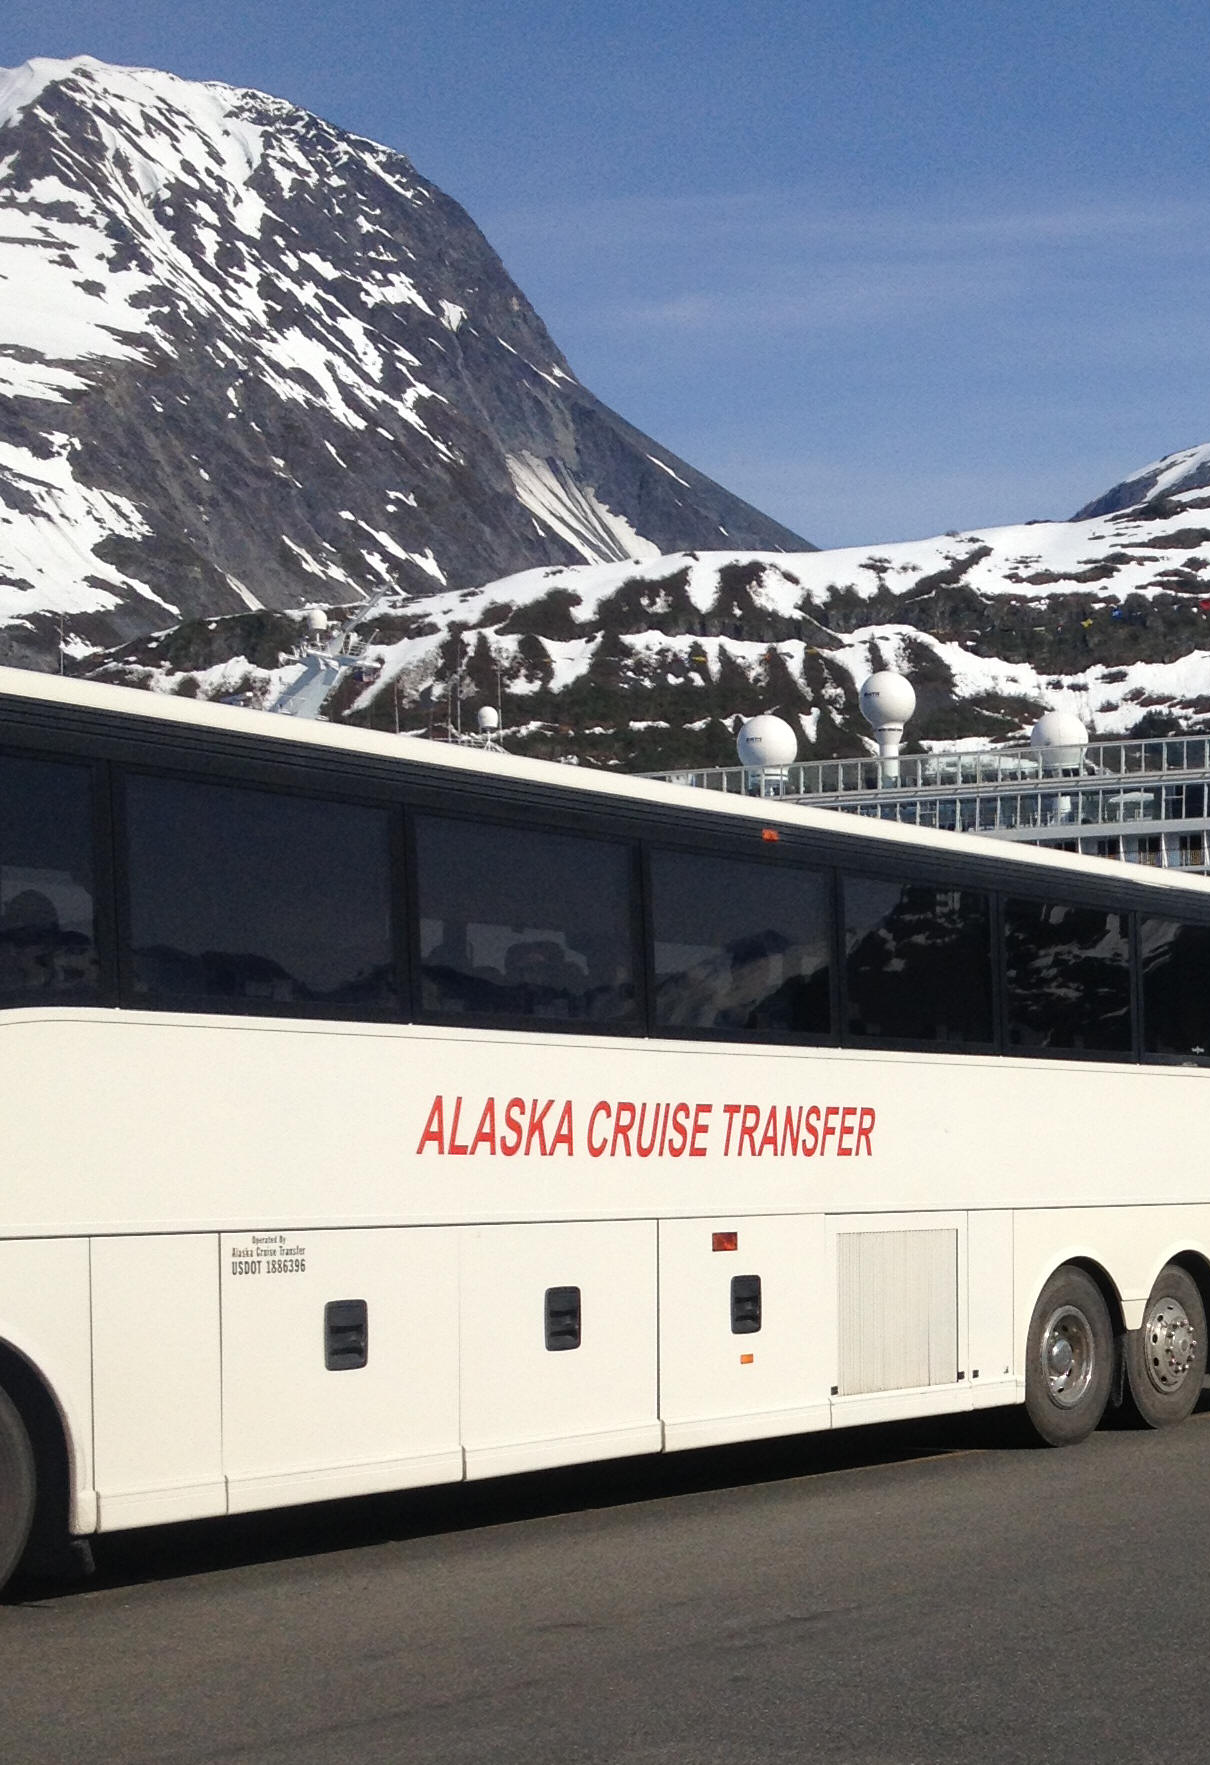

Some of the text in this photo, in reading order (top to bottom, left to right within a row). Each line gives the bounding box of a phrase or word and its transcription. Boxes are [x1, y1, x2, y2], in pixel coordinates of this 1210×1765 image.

[415, 1094, 877, 1157] ALASKA CRUISE TRANSFER
[231, 1245, 306, 1258] Alaska Cruise Transfer
[231, 1258, 306, 1275] USDOT 1886396
